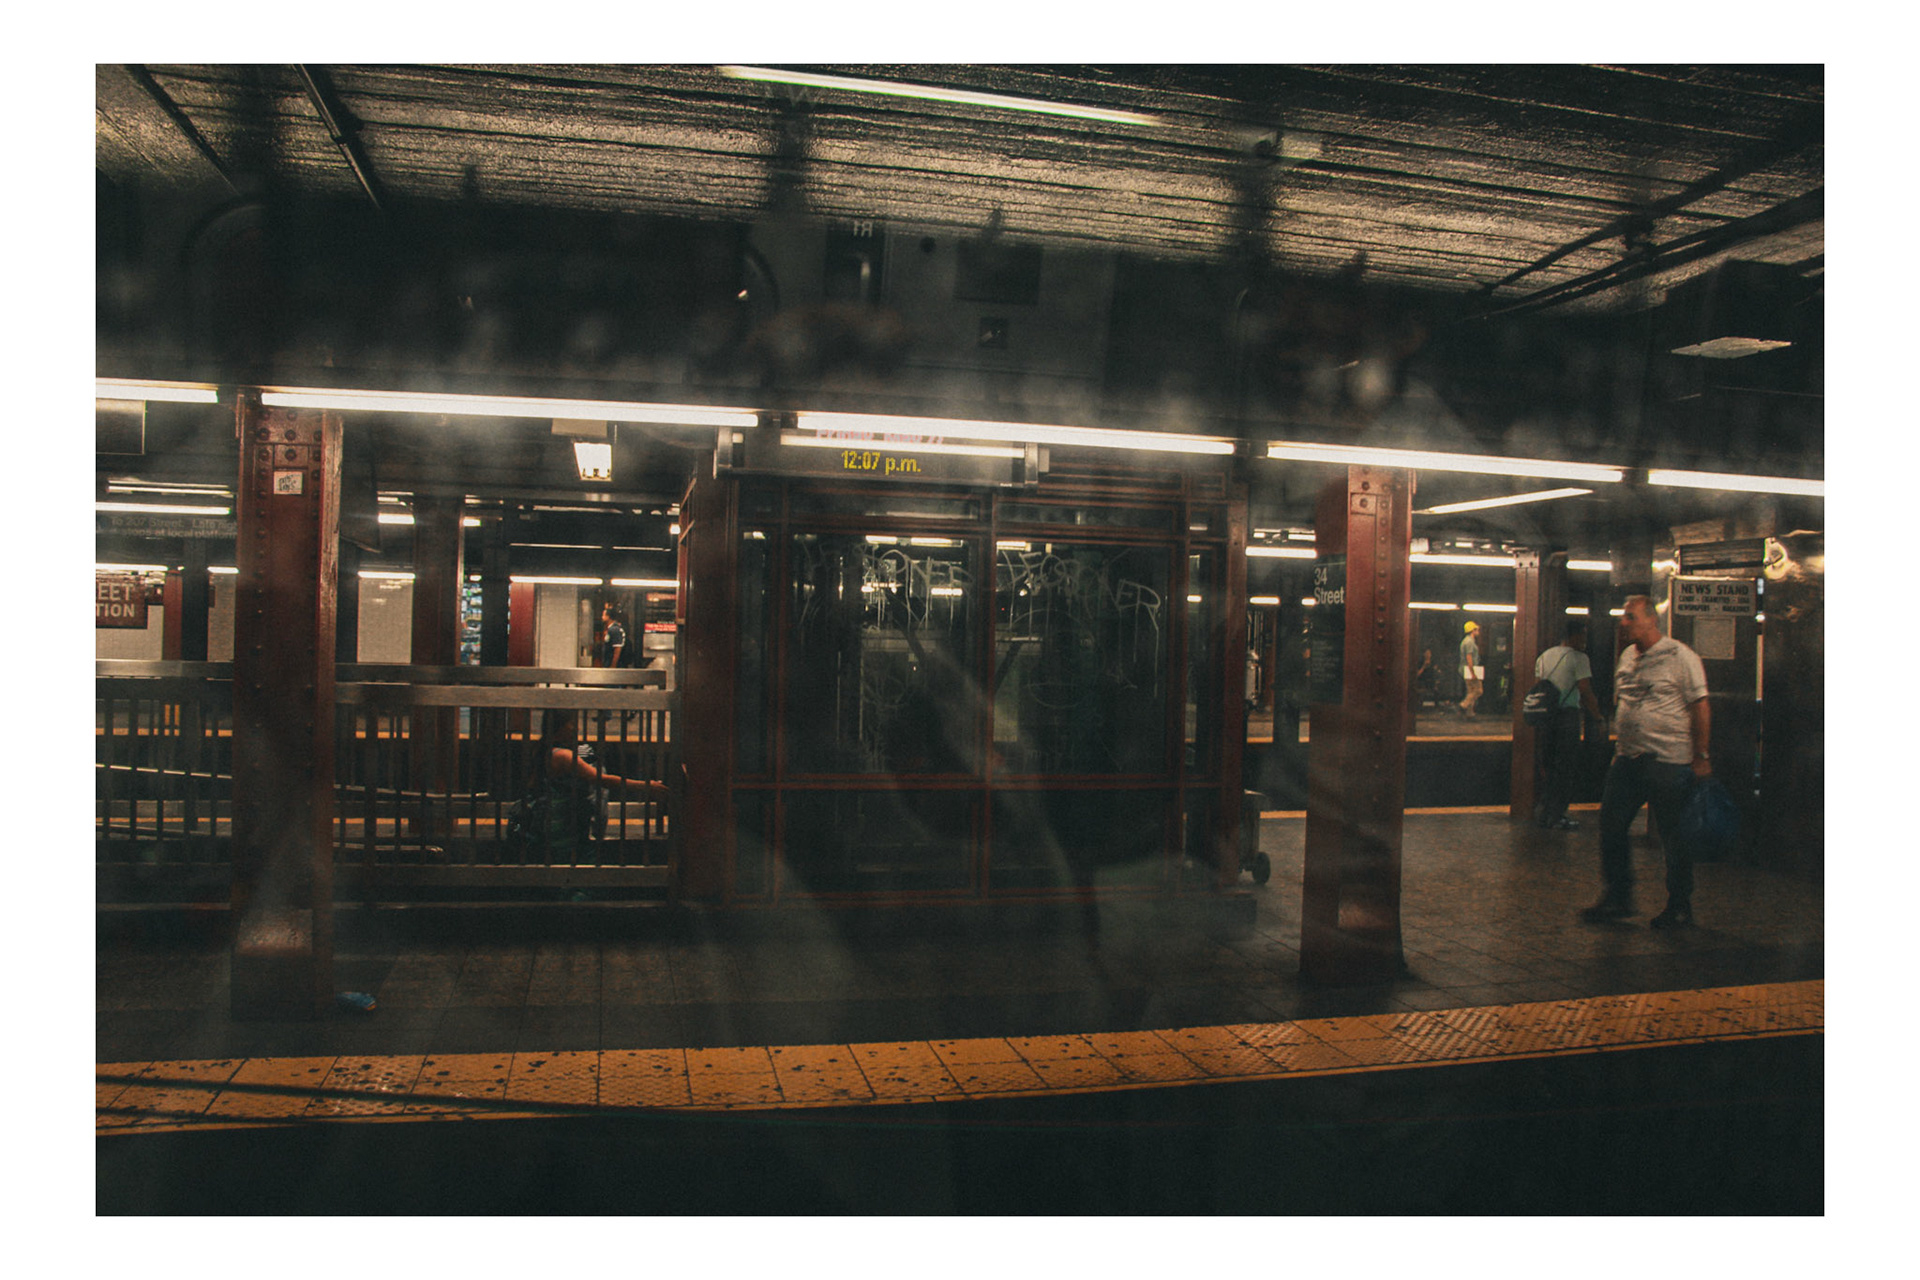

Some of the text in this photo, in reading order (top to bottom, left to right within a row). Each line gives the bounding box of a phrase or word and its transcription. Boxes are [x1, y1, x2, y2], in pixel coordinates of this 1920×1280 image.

[842, 450, 921, 476] 12:07 p.m.
[1314, 567, 1328, 585] 34
[1314, 586, 1345, 604] Street
[1681, 583, 1750, 596] NEWS STAND
[96, 603, 135, 617] TION
